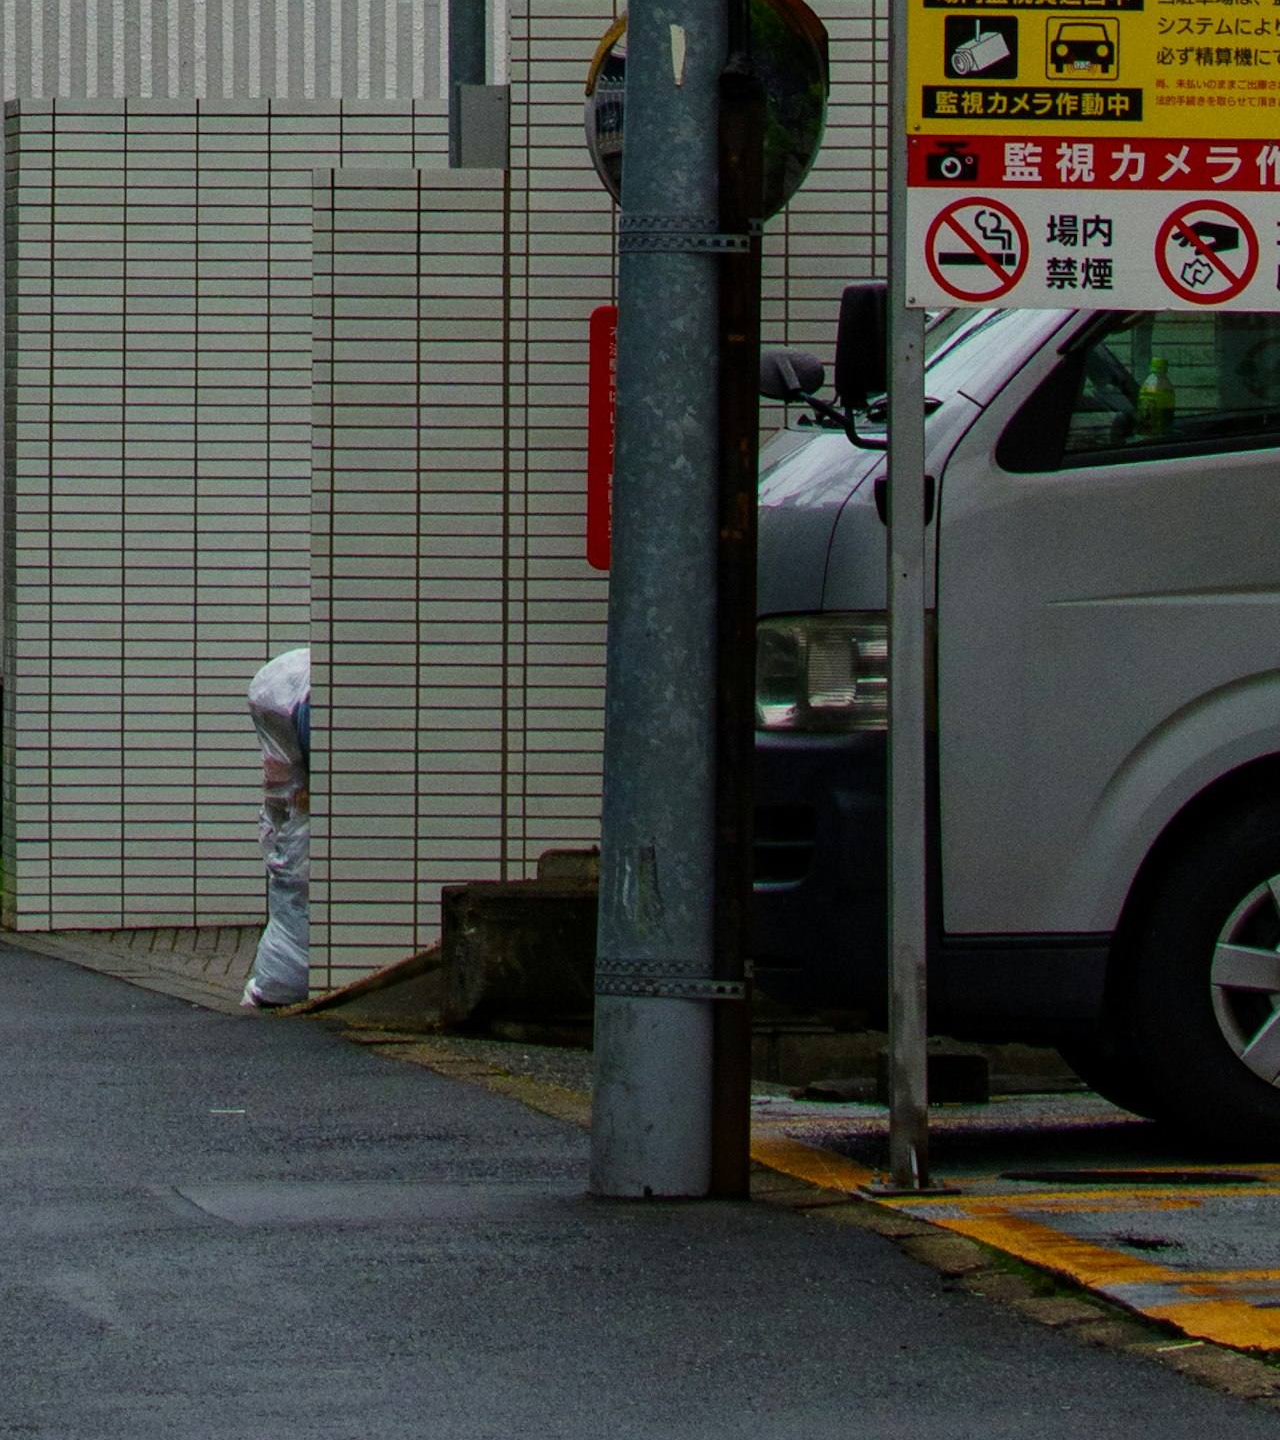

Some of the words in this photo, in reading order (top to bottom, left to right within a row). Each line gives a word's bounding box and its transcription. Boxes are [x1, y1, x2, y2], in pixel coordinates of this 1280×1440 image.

[935, 91, 1131, 117] 監視カメラ作動中
[1046, 214, 1114, 248] 場内
[1046, 258, 1114, 291] 禁煙
